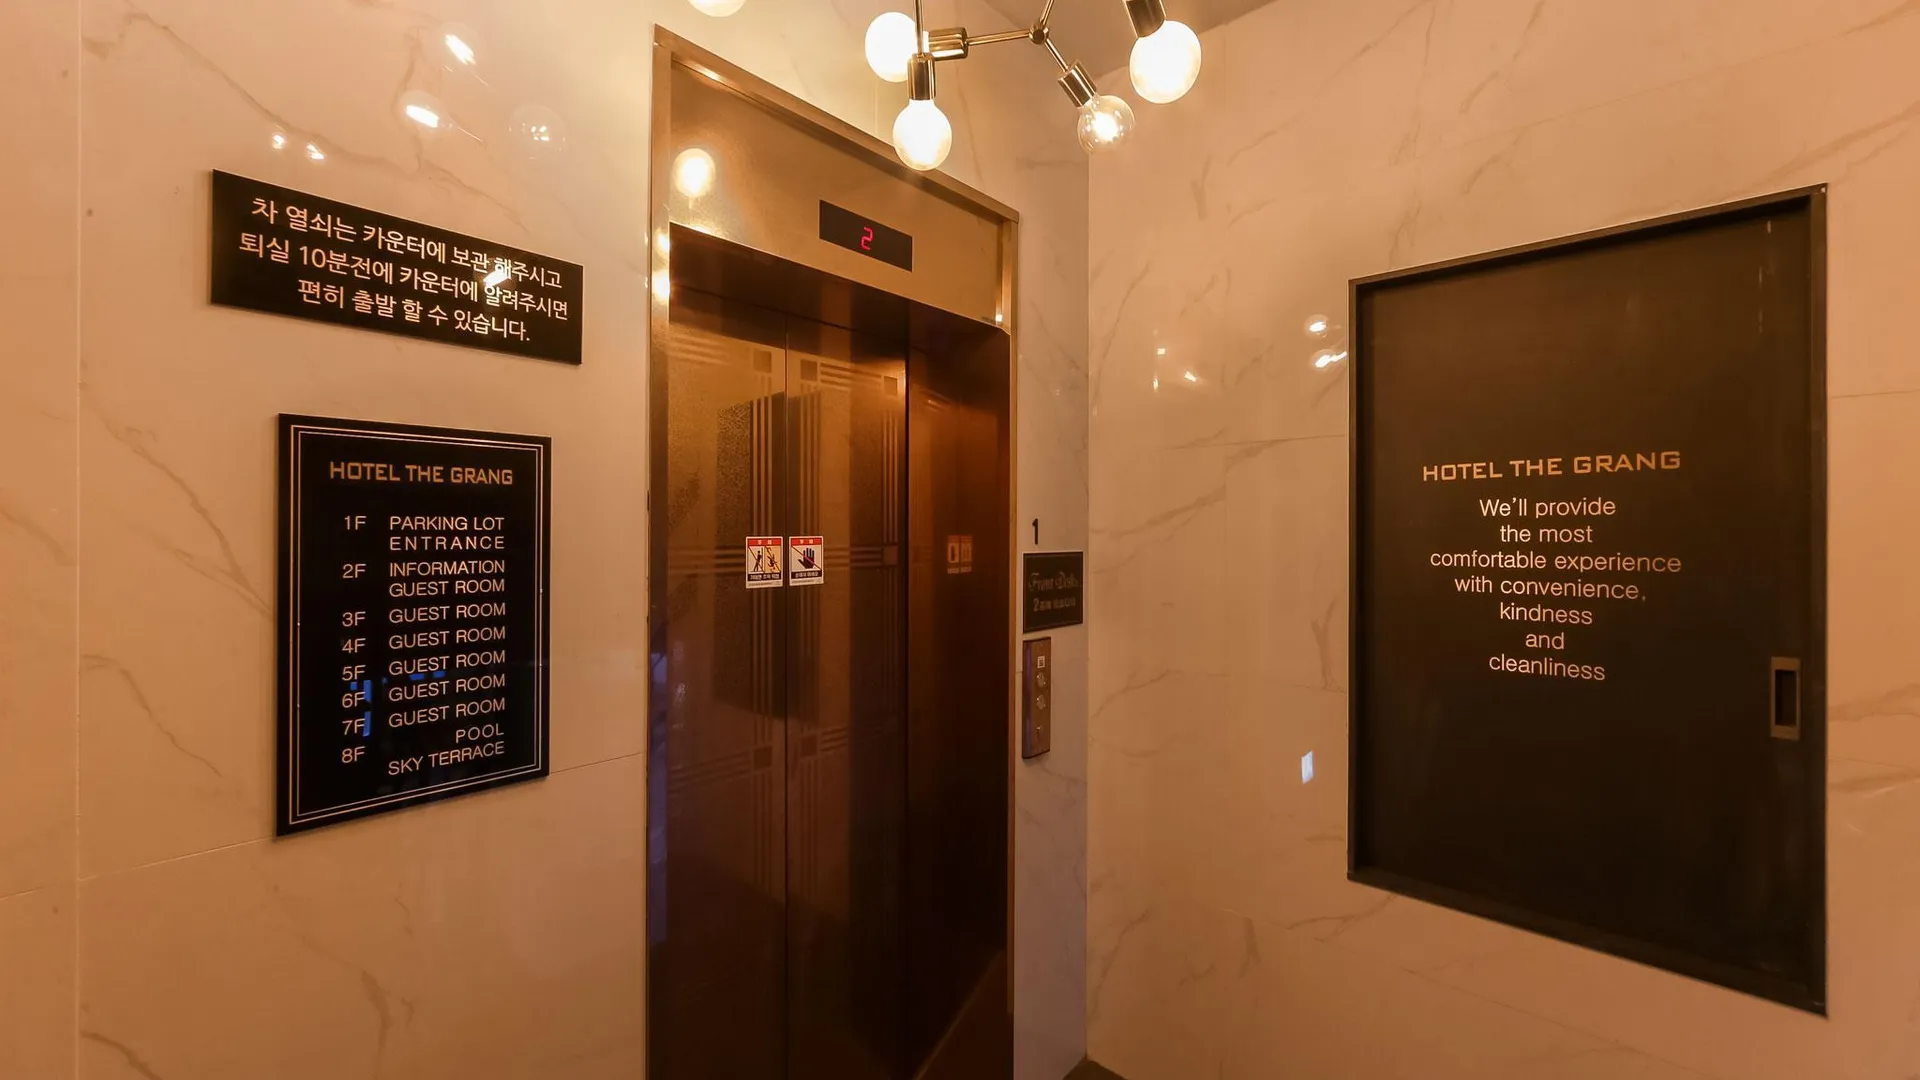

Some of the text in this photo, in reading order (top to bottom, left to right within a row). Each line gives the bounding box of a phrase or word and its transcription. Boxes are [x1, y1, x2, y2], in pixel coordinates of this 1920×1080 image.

[252, 197, 562, 288] 차 열쇠는 카운터에 보관 해주시고
[861, 226, 873, 250] 2
[239, 232, 568, 320] 퇴실 10분전에 카운터에 알려주시면
[298, 279, 531, 342] 편히 출발 할 수 있습니다.
[329, 461, 513, 485] HOTEL THE GRANG
[1423, 451, 1681, 482] HOTEL THE GRANG
[1479, 497, 1616, 519] We'll provide
[344, 515, 505, 531] 1F PARKING LOT
[1032, 518, 1039, 545] 1
[1500, 524, 1593, 543] the most
[389, 536, 505, 551] ENTRANCE
[342, 560, 505, 579] 2F INFORMATION
[1430, 550, 1682, 573] comfortable experience
[389, 578, 505, 598] GUEST ROOM
[1454, 575, 1493, 593] with
[341, 602, 506, 627] 3F GUEST ROOM
[1500, 602, 1593, 625] kindness
[342, 626, 506, 654] 4F GUEST ROOM
[1525, 632, 1565, 650] and
[341, 650, 506, 681] 5F GUEST ROOM
[1489, 653, 1606, 681] cleanliness
[341, 674, 506, 708] 6F GUEST ROOM
[342, 697, 506, 736] 7F GUEST ROOM
[341, 723, 504, 764] 8F POOL
[388, 741, 505, 776] SKY TERRACE
